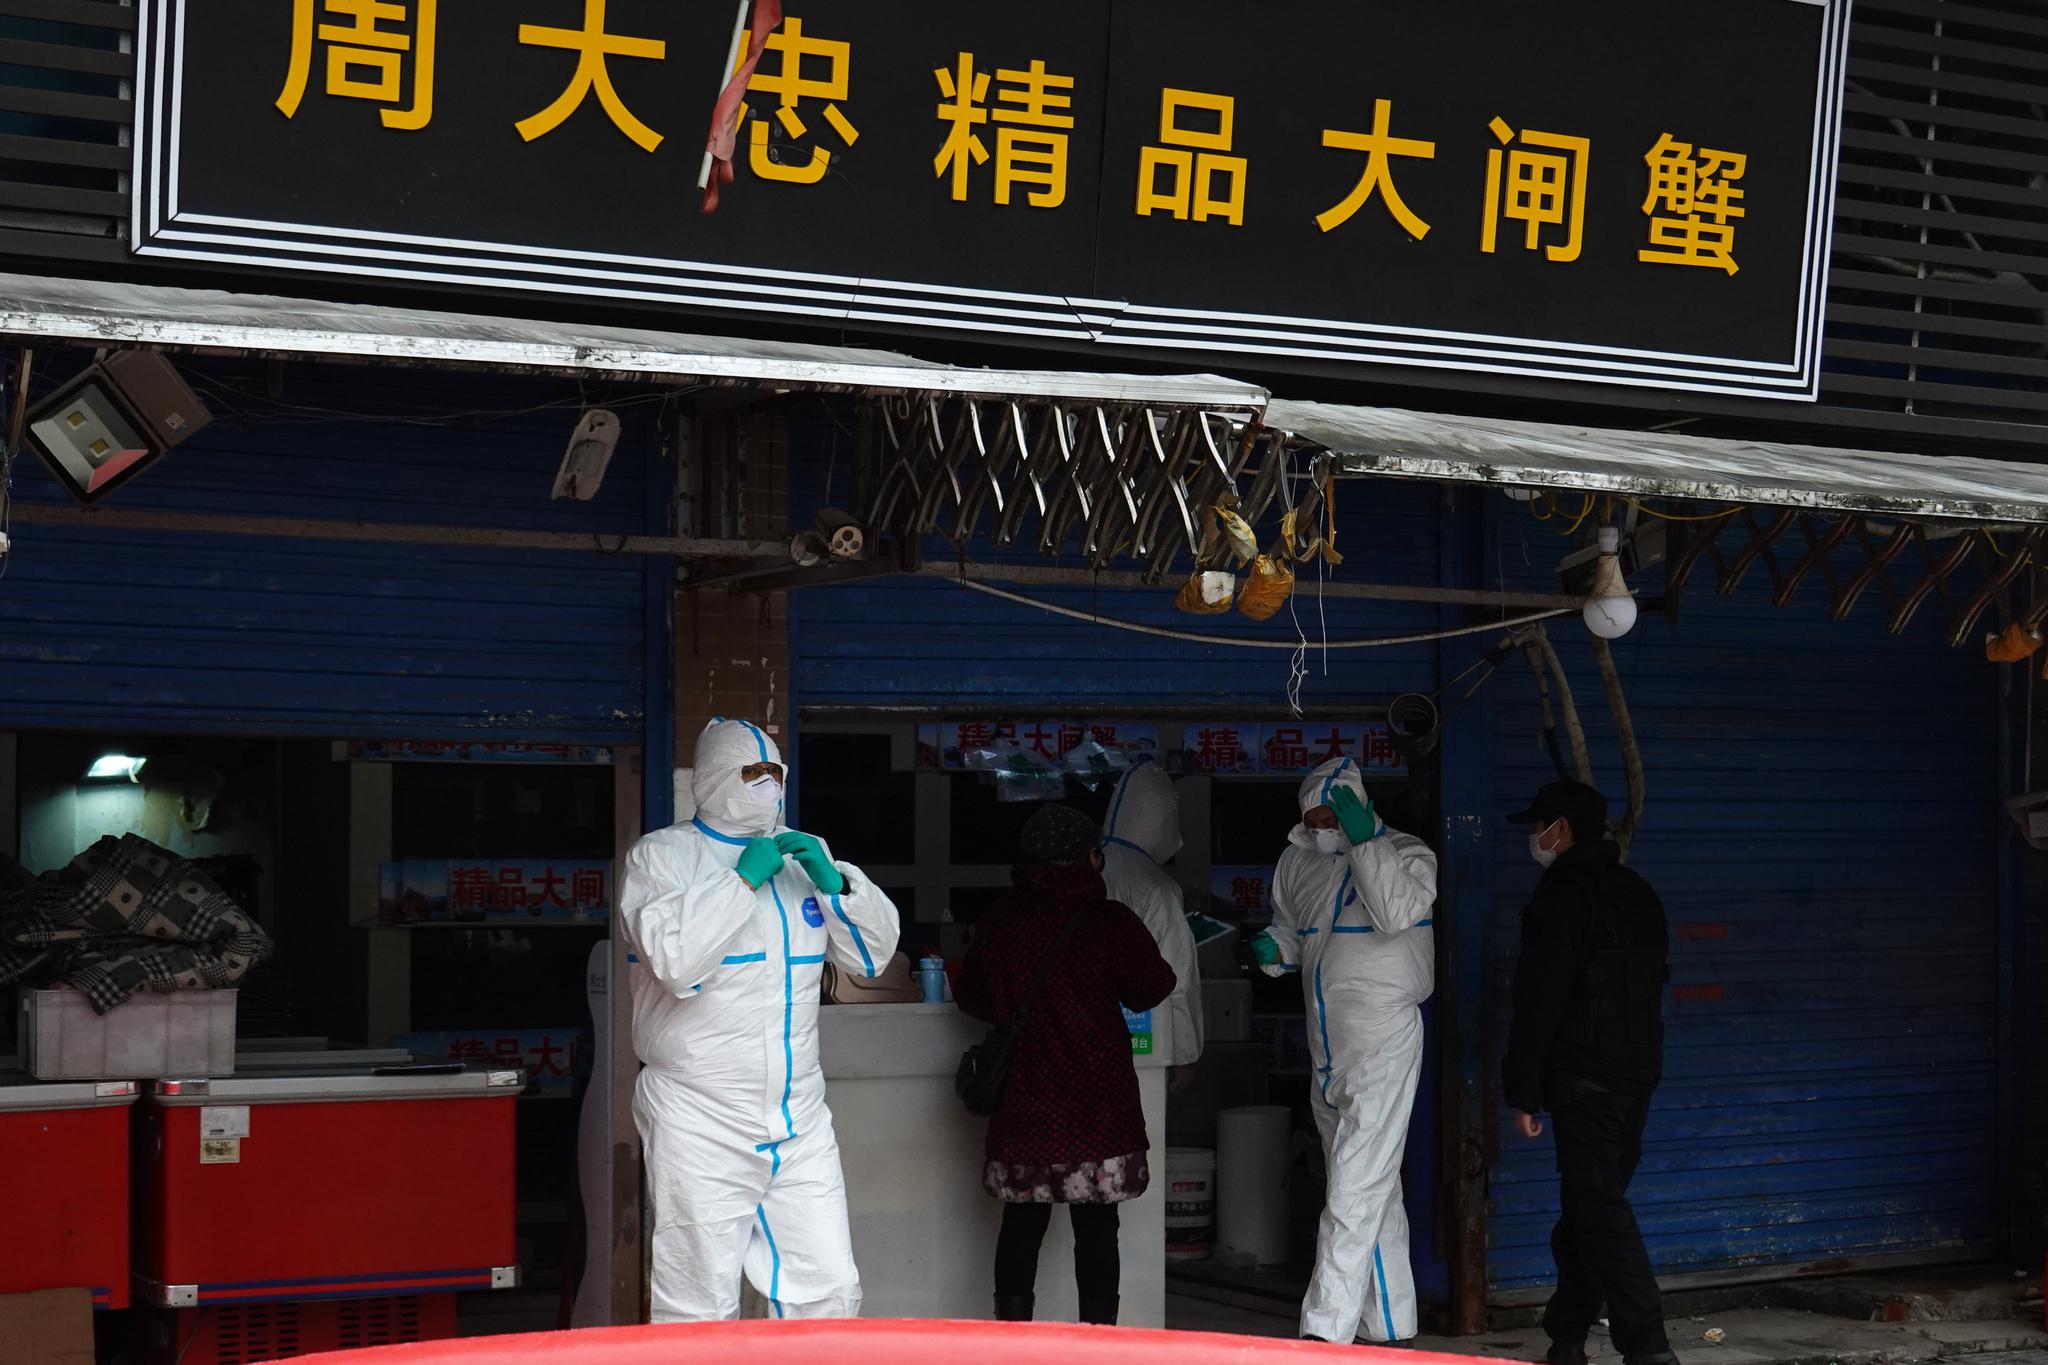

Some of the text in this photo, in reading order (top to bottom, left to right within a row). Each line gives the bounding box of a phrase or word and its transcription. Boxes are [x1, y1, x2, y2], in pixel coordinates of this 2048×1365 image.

[275, 0, 1748, 277] 周大忠精品大闸蟹
[453, 866, 605, 907] 精品大闸
[449, 1036, 576, 1077] 精品大
